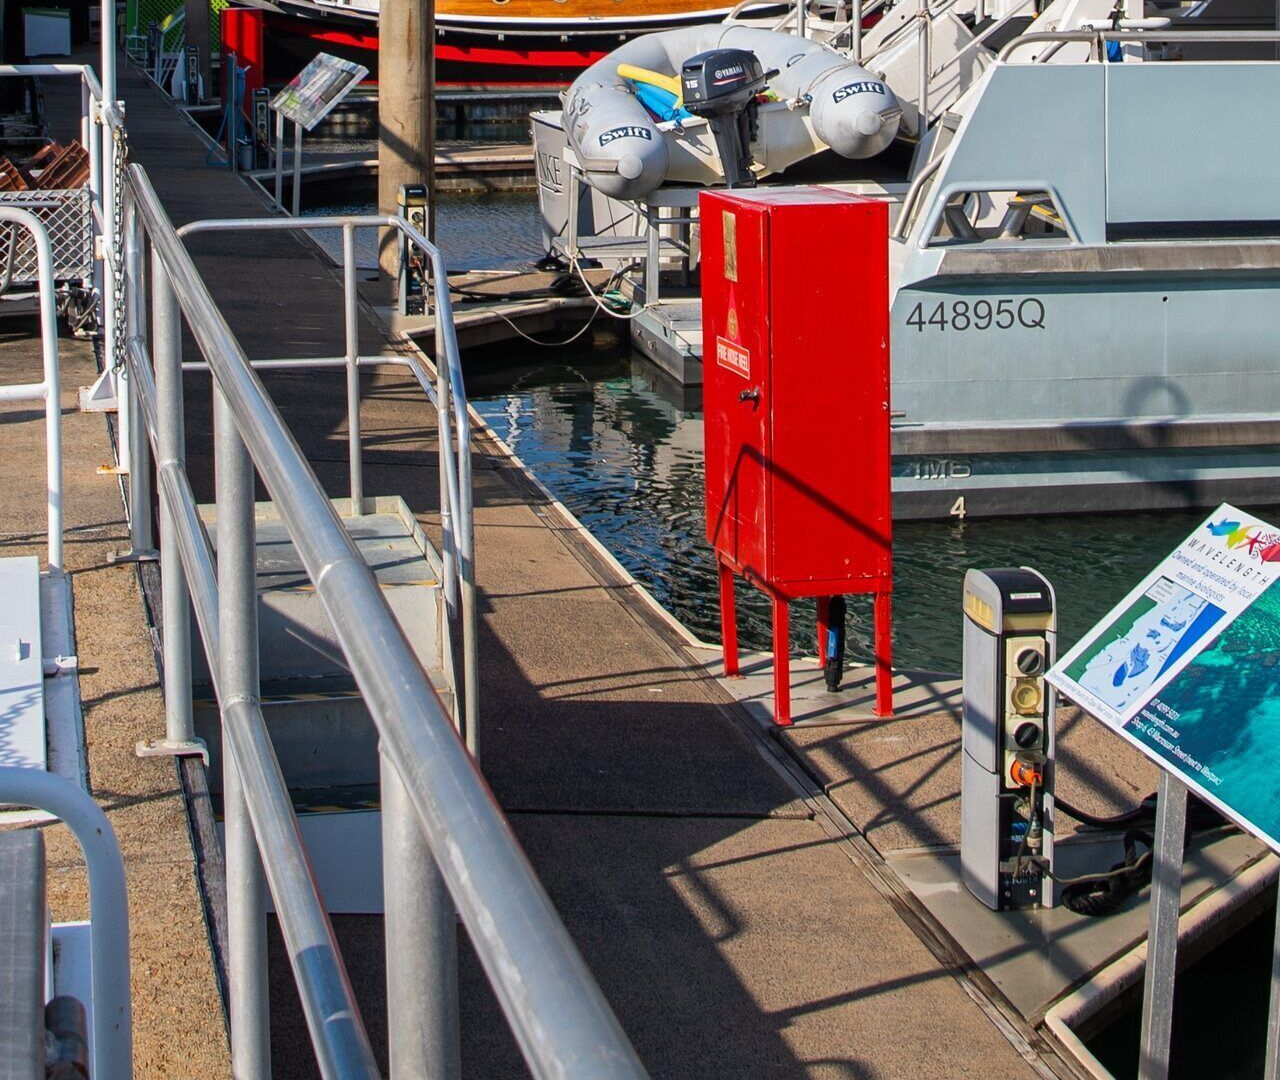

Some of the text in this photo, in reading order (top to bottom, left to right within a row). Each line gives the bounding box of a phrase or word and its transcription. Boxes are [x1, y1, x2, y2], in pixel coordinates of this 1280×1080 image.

[685, 80, 698, 89] 15
[835, 81, 885, 102] Swift
[600, 127, 652, 145] Swift
[906, 297, 1046, 332] 44895Q
[950, 496, 966, 519] 4
[1172, 550, 1194, 565] Owned
[1191, 560, 1206, 572] and
[1201, 567, 1231, 588] operated
[1187, 538, 1269, 585] WAVELENGTH
[1176, 570, 1197, 585] marine
[1193, 581, 1225, 603] biologists
[1150, 697, 1159, 706] 07
[1130, 716, 1145, 729] Shop
[1171, 745, 1187, 759] Street
[1139, 707, 1180, 739] wavelength.com.au
